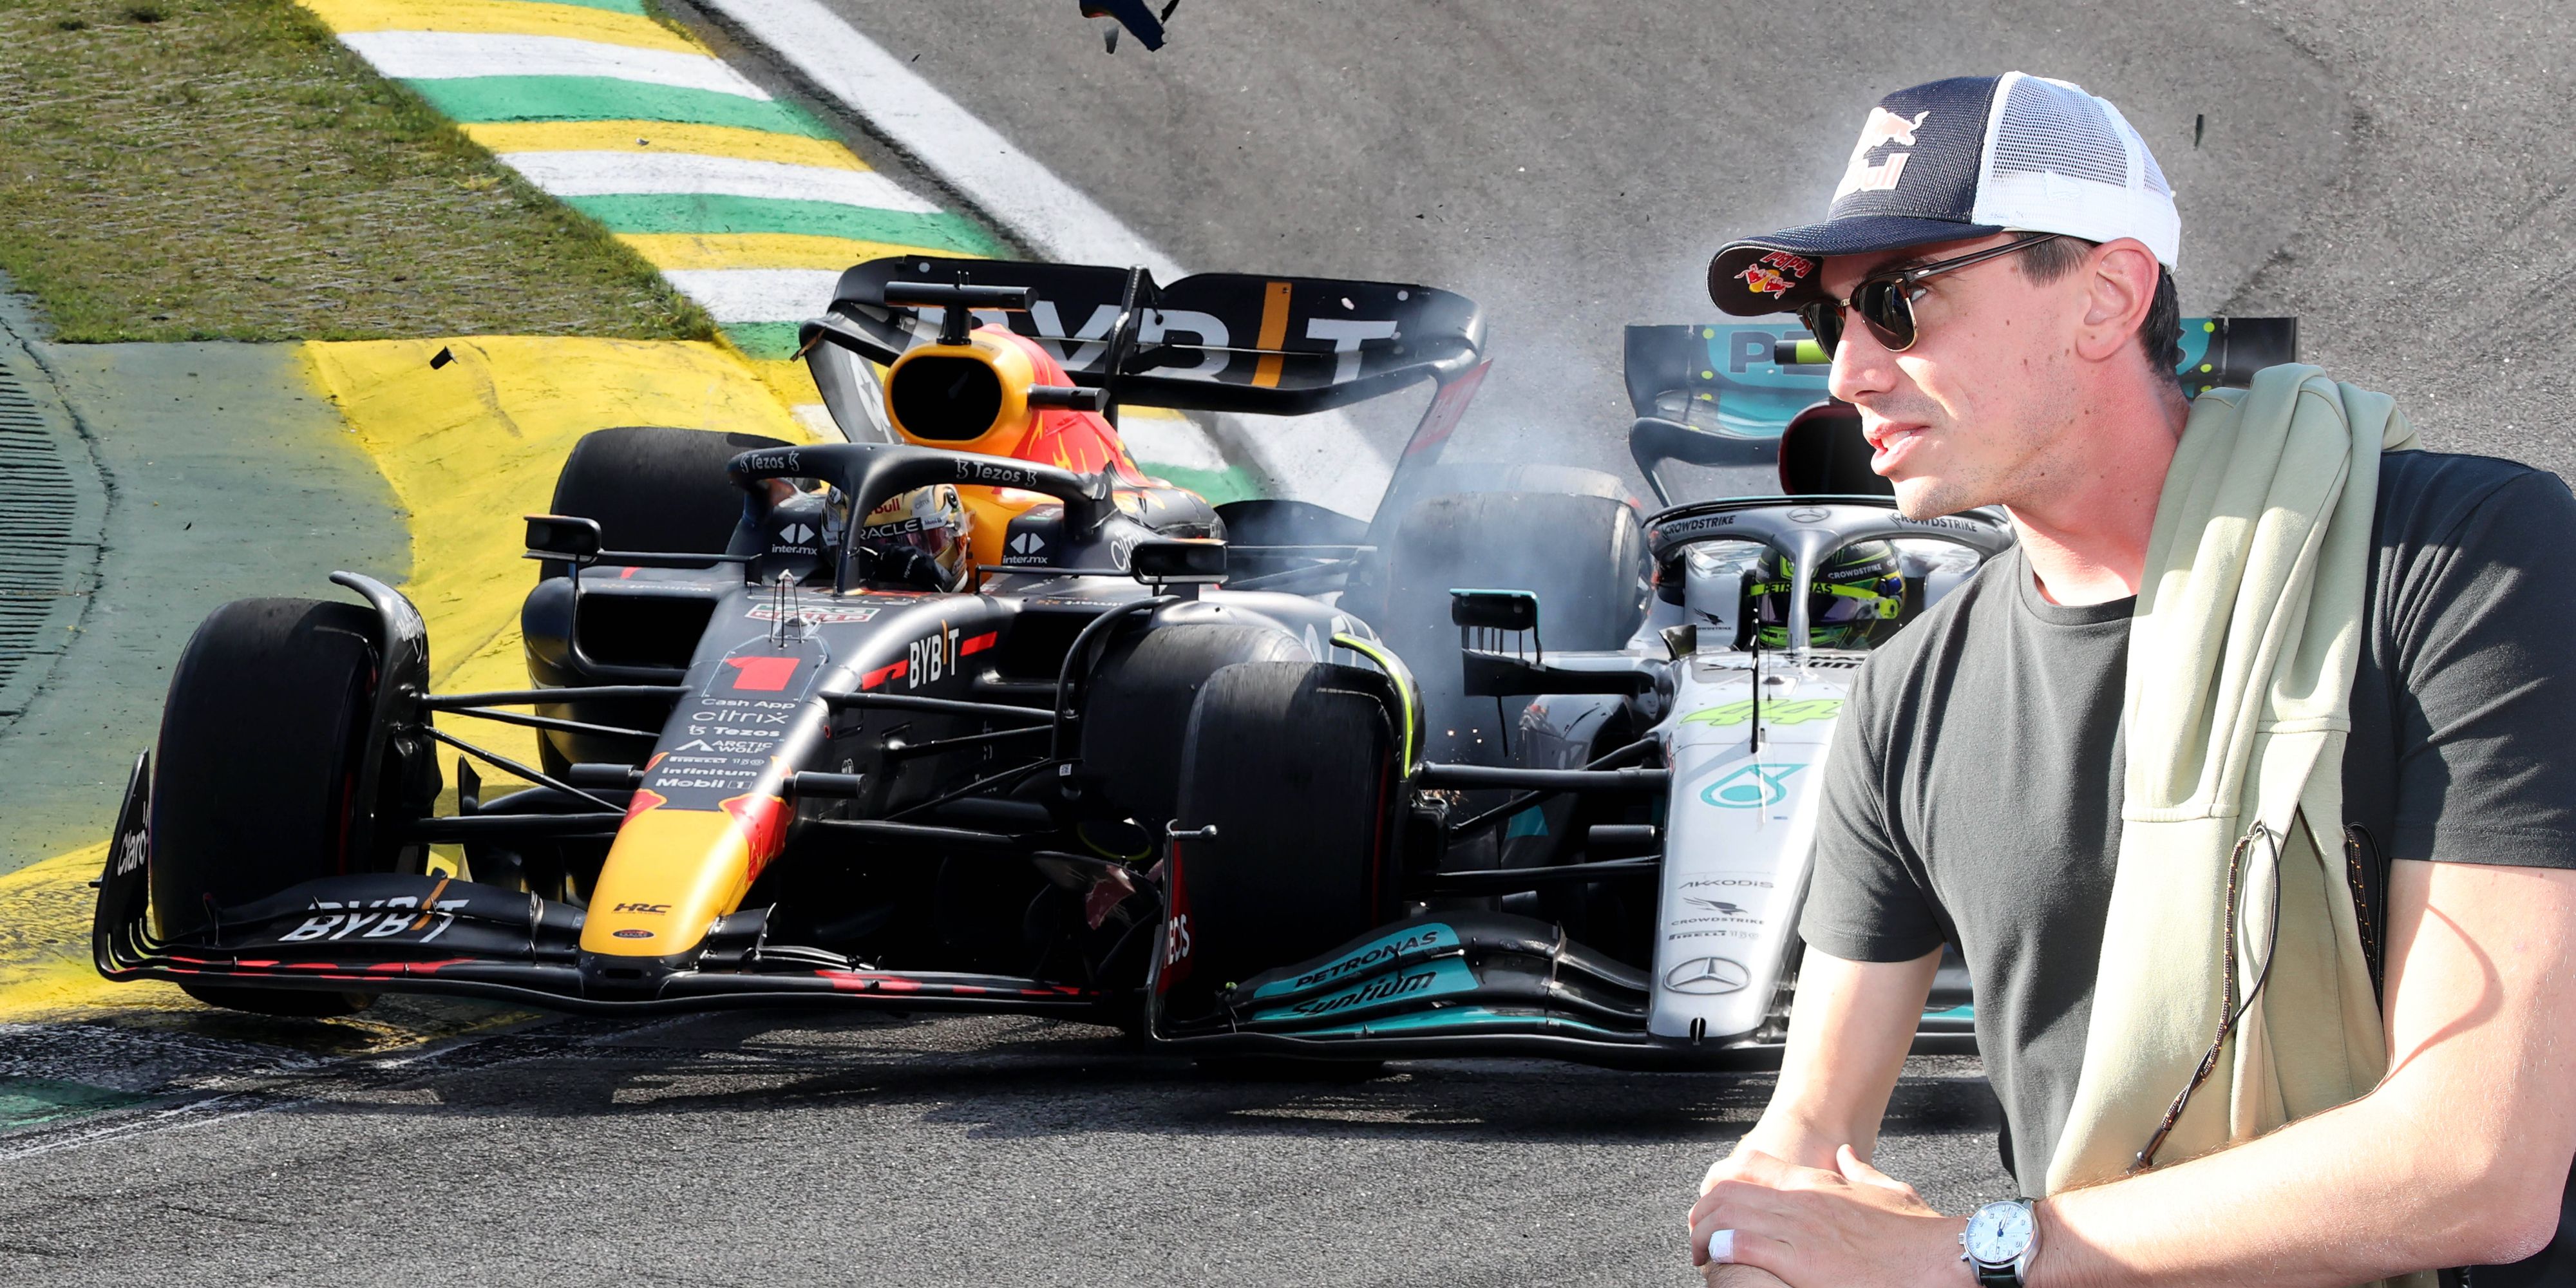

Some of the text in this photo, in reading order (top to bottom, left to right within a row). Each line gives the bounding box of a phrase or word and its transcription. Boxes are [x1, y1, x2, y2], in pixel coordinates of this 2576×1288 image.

[751, 453, 785, 469] Tezos
[972, 463, 1021, 482] Tezos
[841, 519, 920, 540] RACLE
[1665, 515, 1736, 535] CROWDSTRIKE
[772, 544, 817, 556] inter.mx
[1003, 554, 1048, 565] inter.mx
[1828, 564, 1882, 579] CROWDSTRIKE
[1764, 582, 1833, 593] PETRAS
[909, 620, 960, 690] BYBIT
[724, 656, 800, 690] 1
[754, 701, 796, 709] App
[713, 726, 781, 737] Tezos
[712, 740, 773, 748] ARCTIC
[655, 778, 726, 789] Mobil
[117, 829, 147, 876] Claro
[278, 878, 469, 943] BYBIT
[614, 903, 672, 914] HRC
[1671, 917, 1765, 926] CROWDSTRIKE
[1164, 914, 1190, 969] EOS
[1669, 930, 1727, 941] PIRELLI
[1295, 932, 1437, 988] PETRONAS
[1291, 971, 1437, 1016] Syntium
